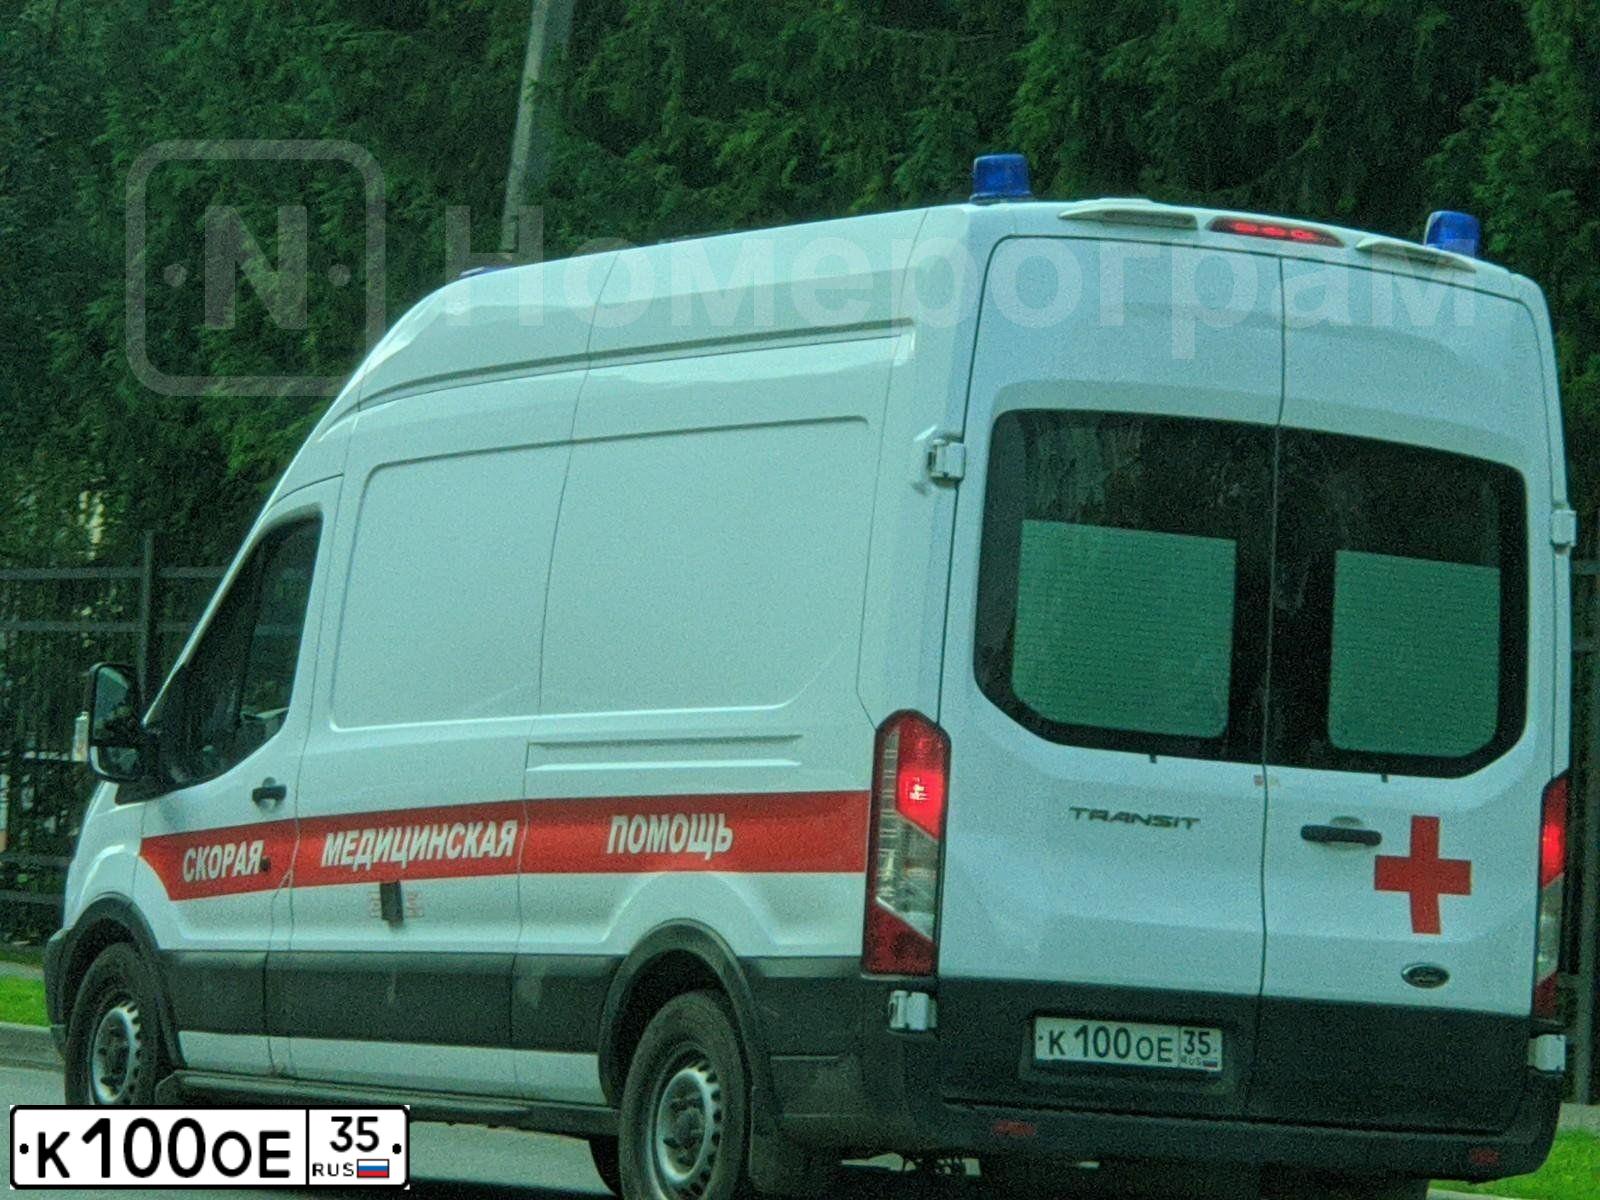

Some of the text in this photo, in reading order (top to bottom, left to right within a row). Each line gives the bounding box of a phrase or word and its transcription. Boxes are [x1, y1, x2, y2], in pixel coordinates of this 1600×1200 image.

[1069, 807, 1200, 830] TRANSIT
[182, 813, 734, 883] СКОРАЯ МЕДИЦИНСКАЯ ПОМОЩЬ
